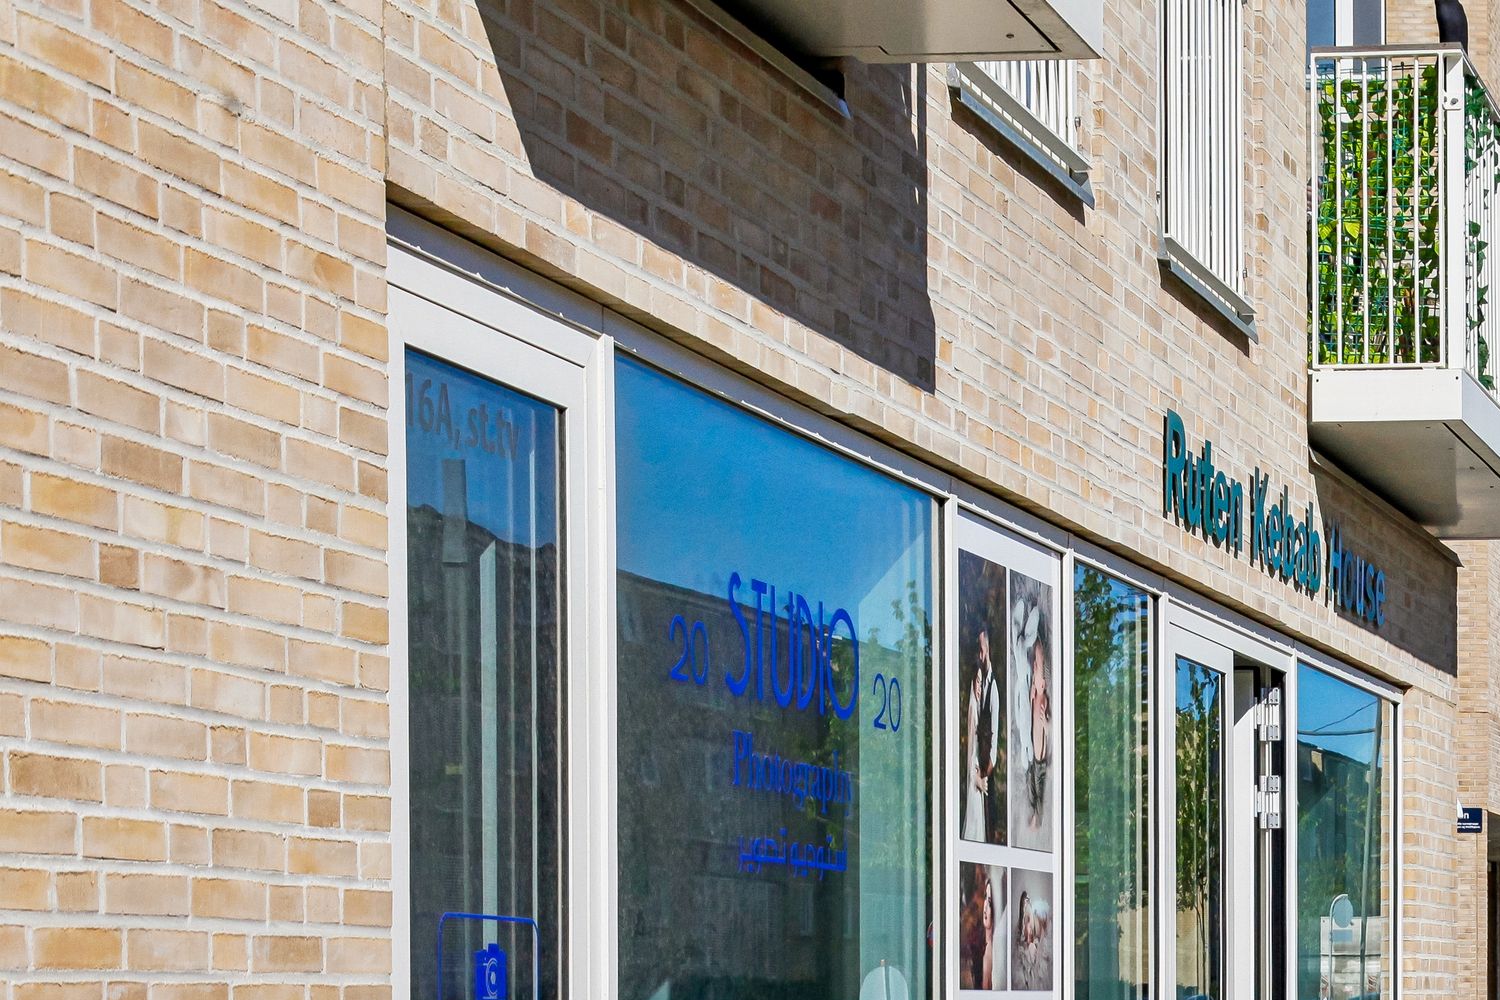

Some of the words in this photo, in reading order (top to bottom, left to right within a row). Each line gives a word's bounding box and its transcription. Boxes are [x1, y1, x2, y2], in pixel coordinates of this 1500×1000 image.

[1166, 408, 1243, 552] Ruten
[1253, 466, 1322, 593] Kebab
[1329, 525, 1386, 626] House
[669, 614, 709, 686] 20
[725, 571, 859, 721] STUDIO
[872, 672, 902, 733] 20
[732, 728, 853, 817] Photography
